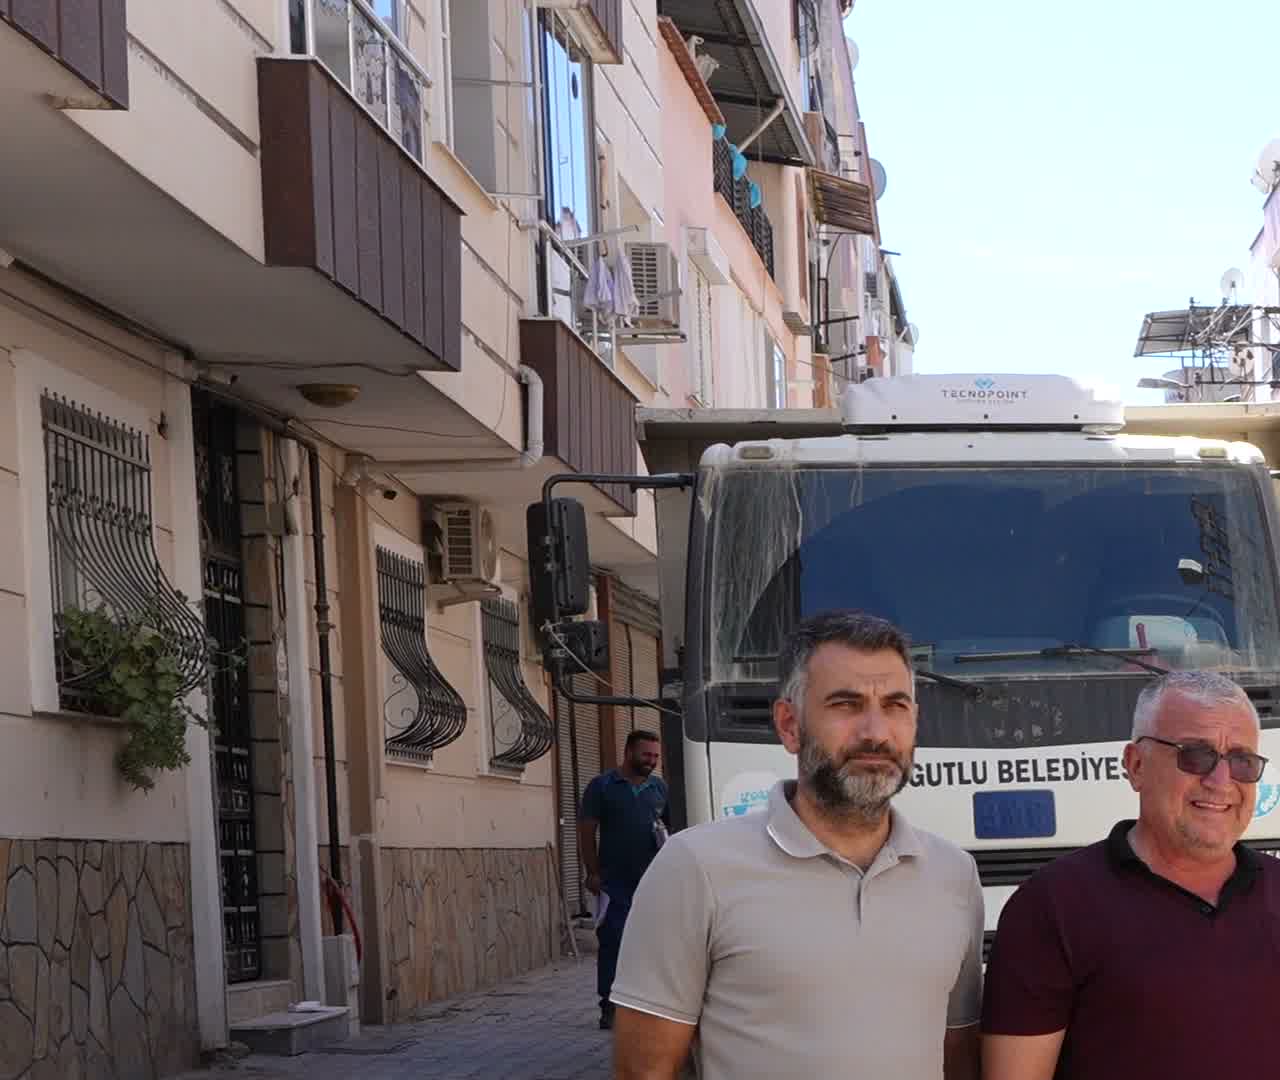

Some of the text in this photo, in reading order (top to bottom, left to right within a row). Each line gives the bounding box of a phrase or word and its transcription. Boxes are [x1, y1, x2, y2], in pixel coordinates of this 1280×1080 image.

[941, 389, 1028, 399] TECNOPOINT
[909, 752, 1129, 788] GUTLU BELEDİYE
